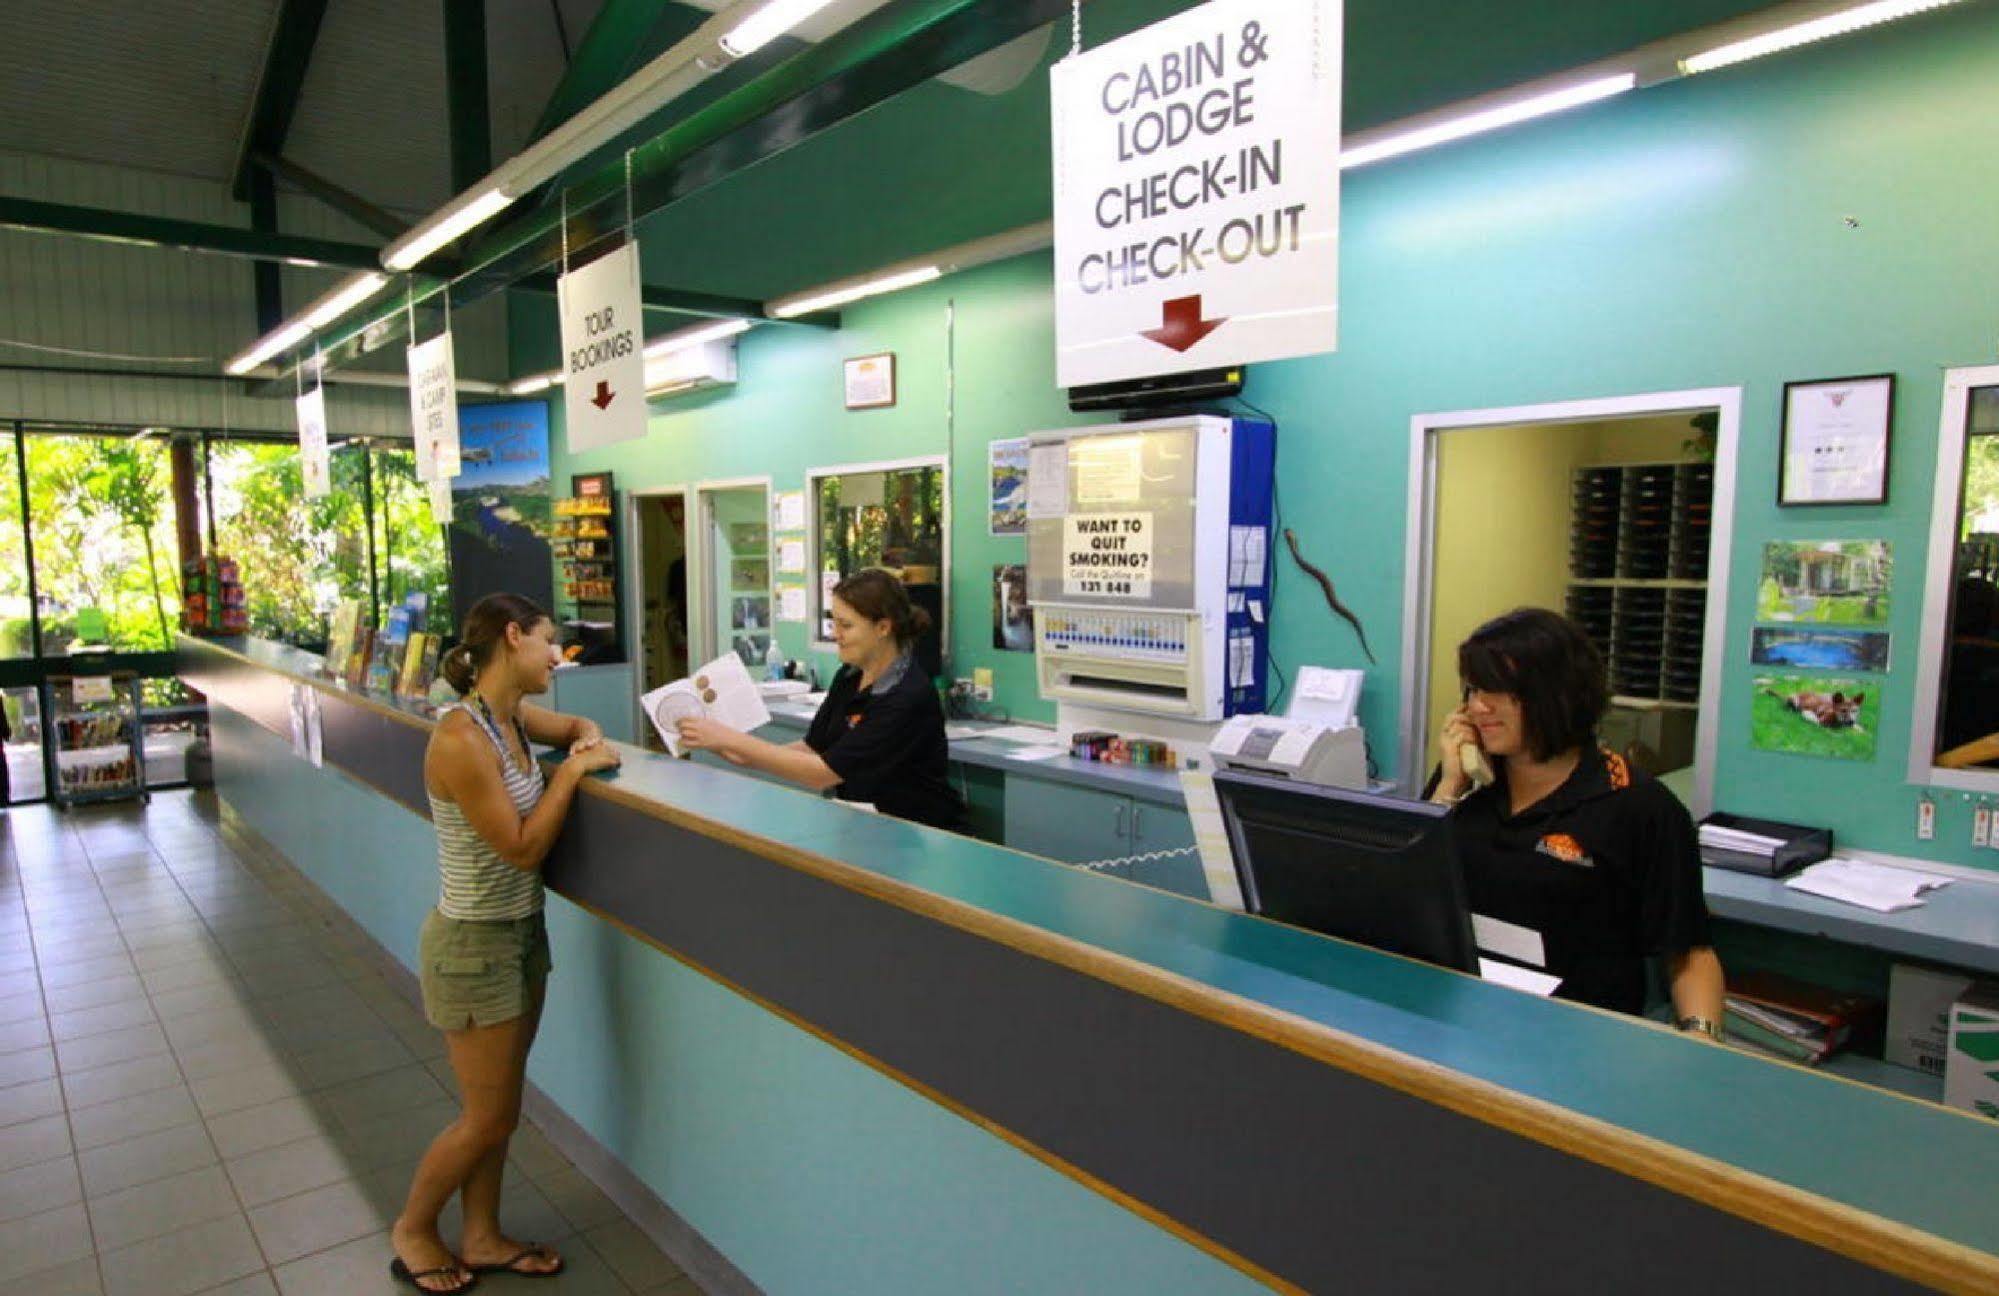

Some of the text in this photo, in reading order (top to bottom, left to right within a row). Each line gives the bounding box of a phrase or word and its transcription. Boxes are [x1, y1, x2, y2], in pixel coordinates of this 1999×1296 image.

[1102, 20, 1268, 114] CABIN &
[1118, 78, 1254, 161] LODGE
[1094, 138, 1282, 229] CHECK-IN
[1078, 204, 1306, 294] CHECK-OUT
[585, 306, 614, 337] TOUR
[570, 330, 633, 373] BOOKINGS
[1077, 519, 1142, 533] WANT TO
[1091, 536, 1126, 550] QUIT
[1069, 552, 1148, 567] SMOKING?
